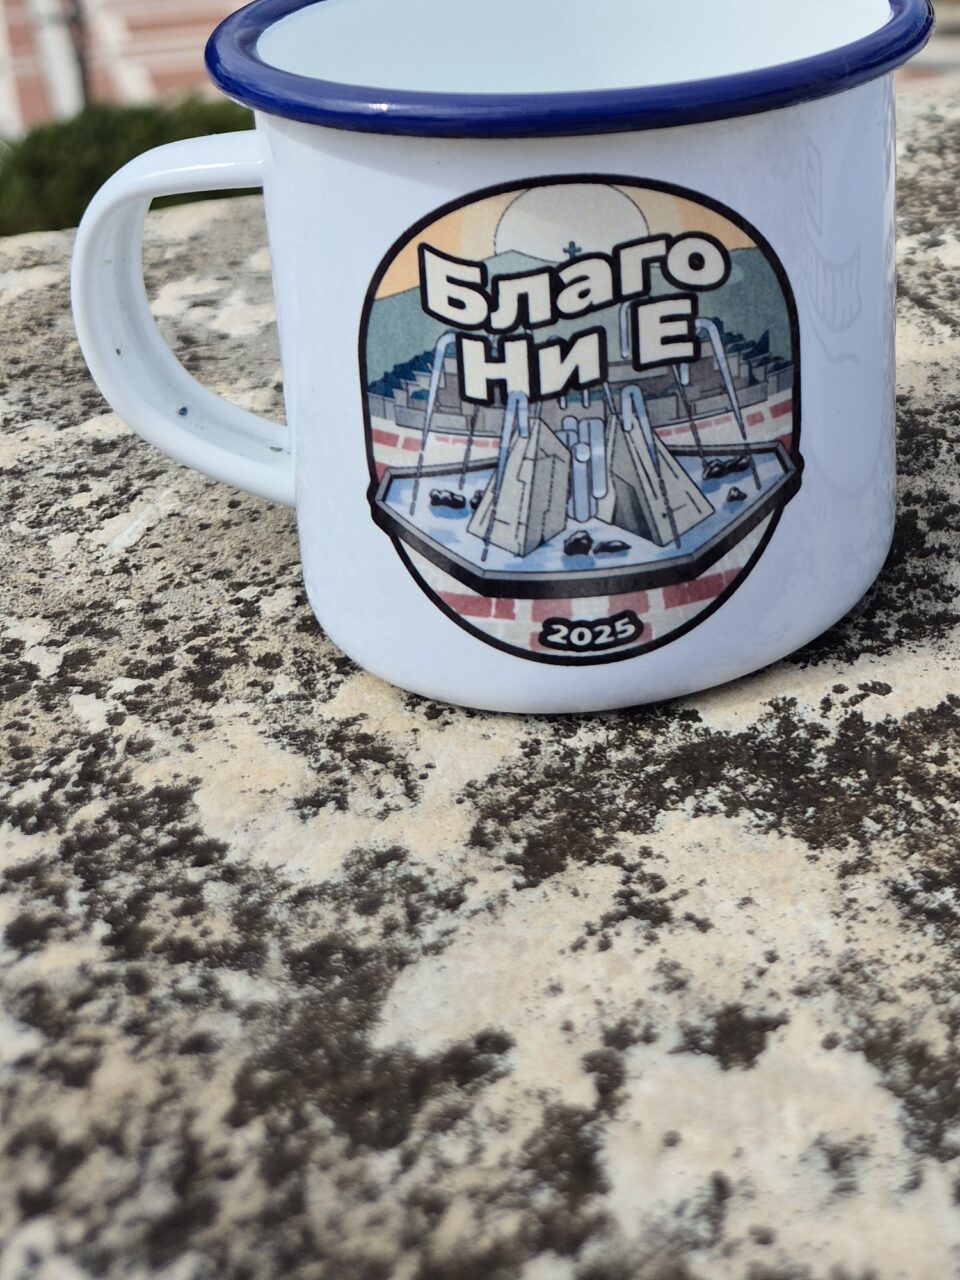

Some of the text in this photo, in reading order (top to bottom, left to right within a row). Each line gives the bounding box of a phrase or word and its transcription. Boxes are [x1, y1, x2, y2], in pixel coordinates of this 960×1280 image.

[420, 233, 728, 333] Благо
[634, 294, 698, 369] Е
[540, 613, 641, 650] 2025
